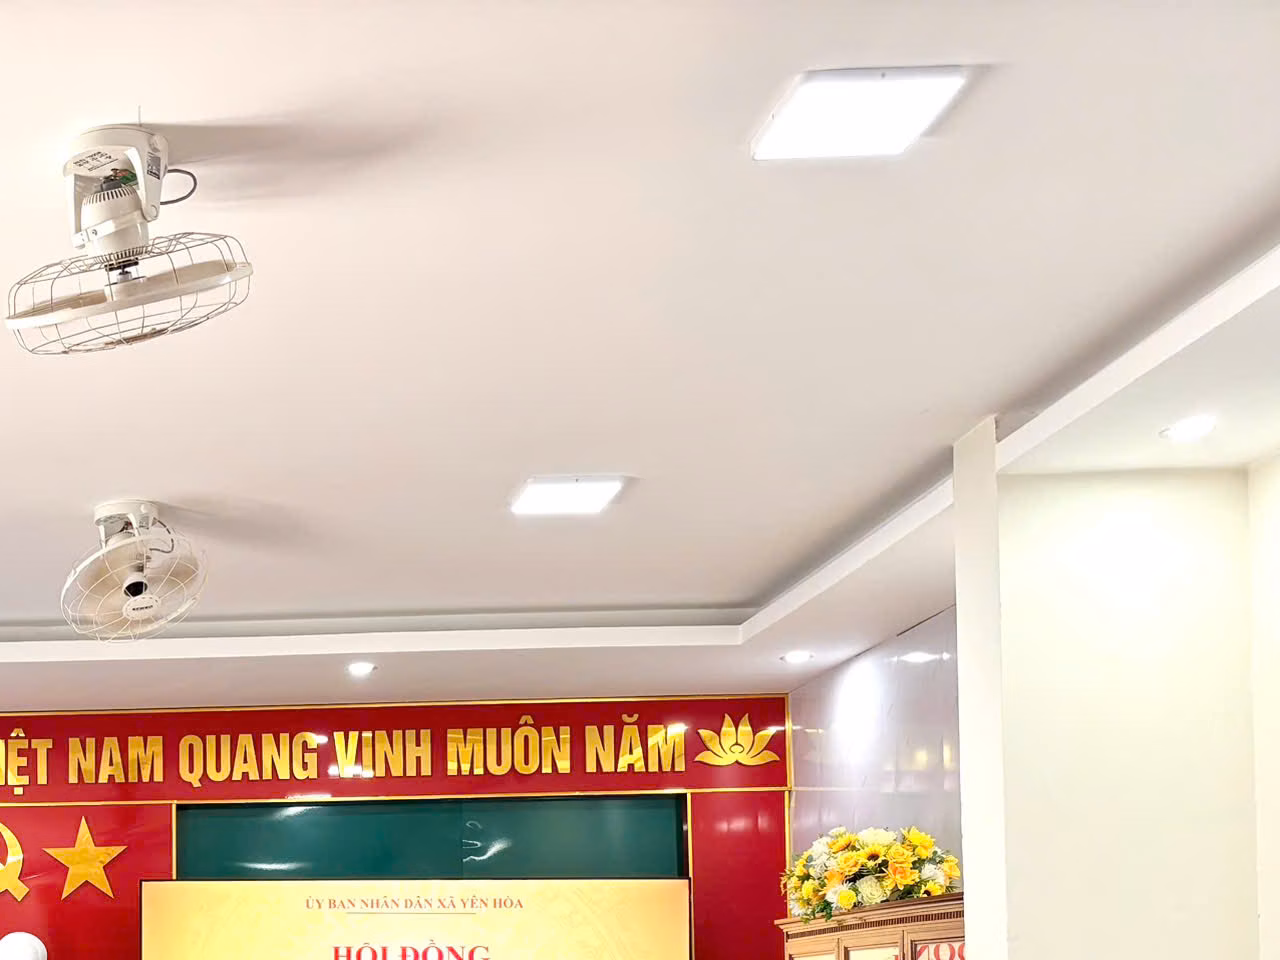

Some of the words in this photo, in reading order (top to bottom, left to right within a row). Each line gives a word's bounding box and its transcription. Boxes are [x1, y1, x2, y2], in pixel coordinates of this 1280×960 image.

[68, 735, 164, 784] NAM
[178, 732, 319, 788] QUANG
[333, 729, 432, 778] VINH
[447, 715, 571, 776] MUÔN
[585, 713, 686, 773] NĂM
[306, 896, 324, 910] ỦY
[328, 899, 356, 910] BAN
[360, 896, 400, 909] NHÂN
[404, 896, 433, 909] DÂN
[437, 896, 457, 909] XÃ
[461, 895, 489, 909] YÊN
[493, 896, 524, 909] HÒA
